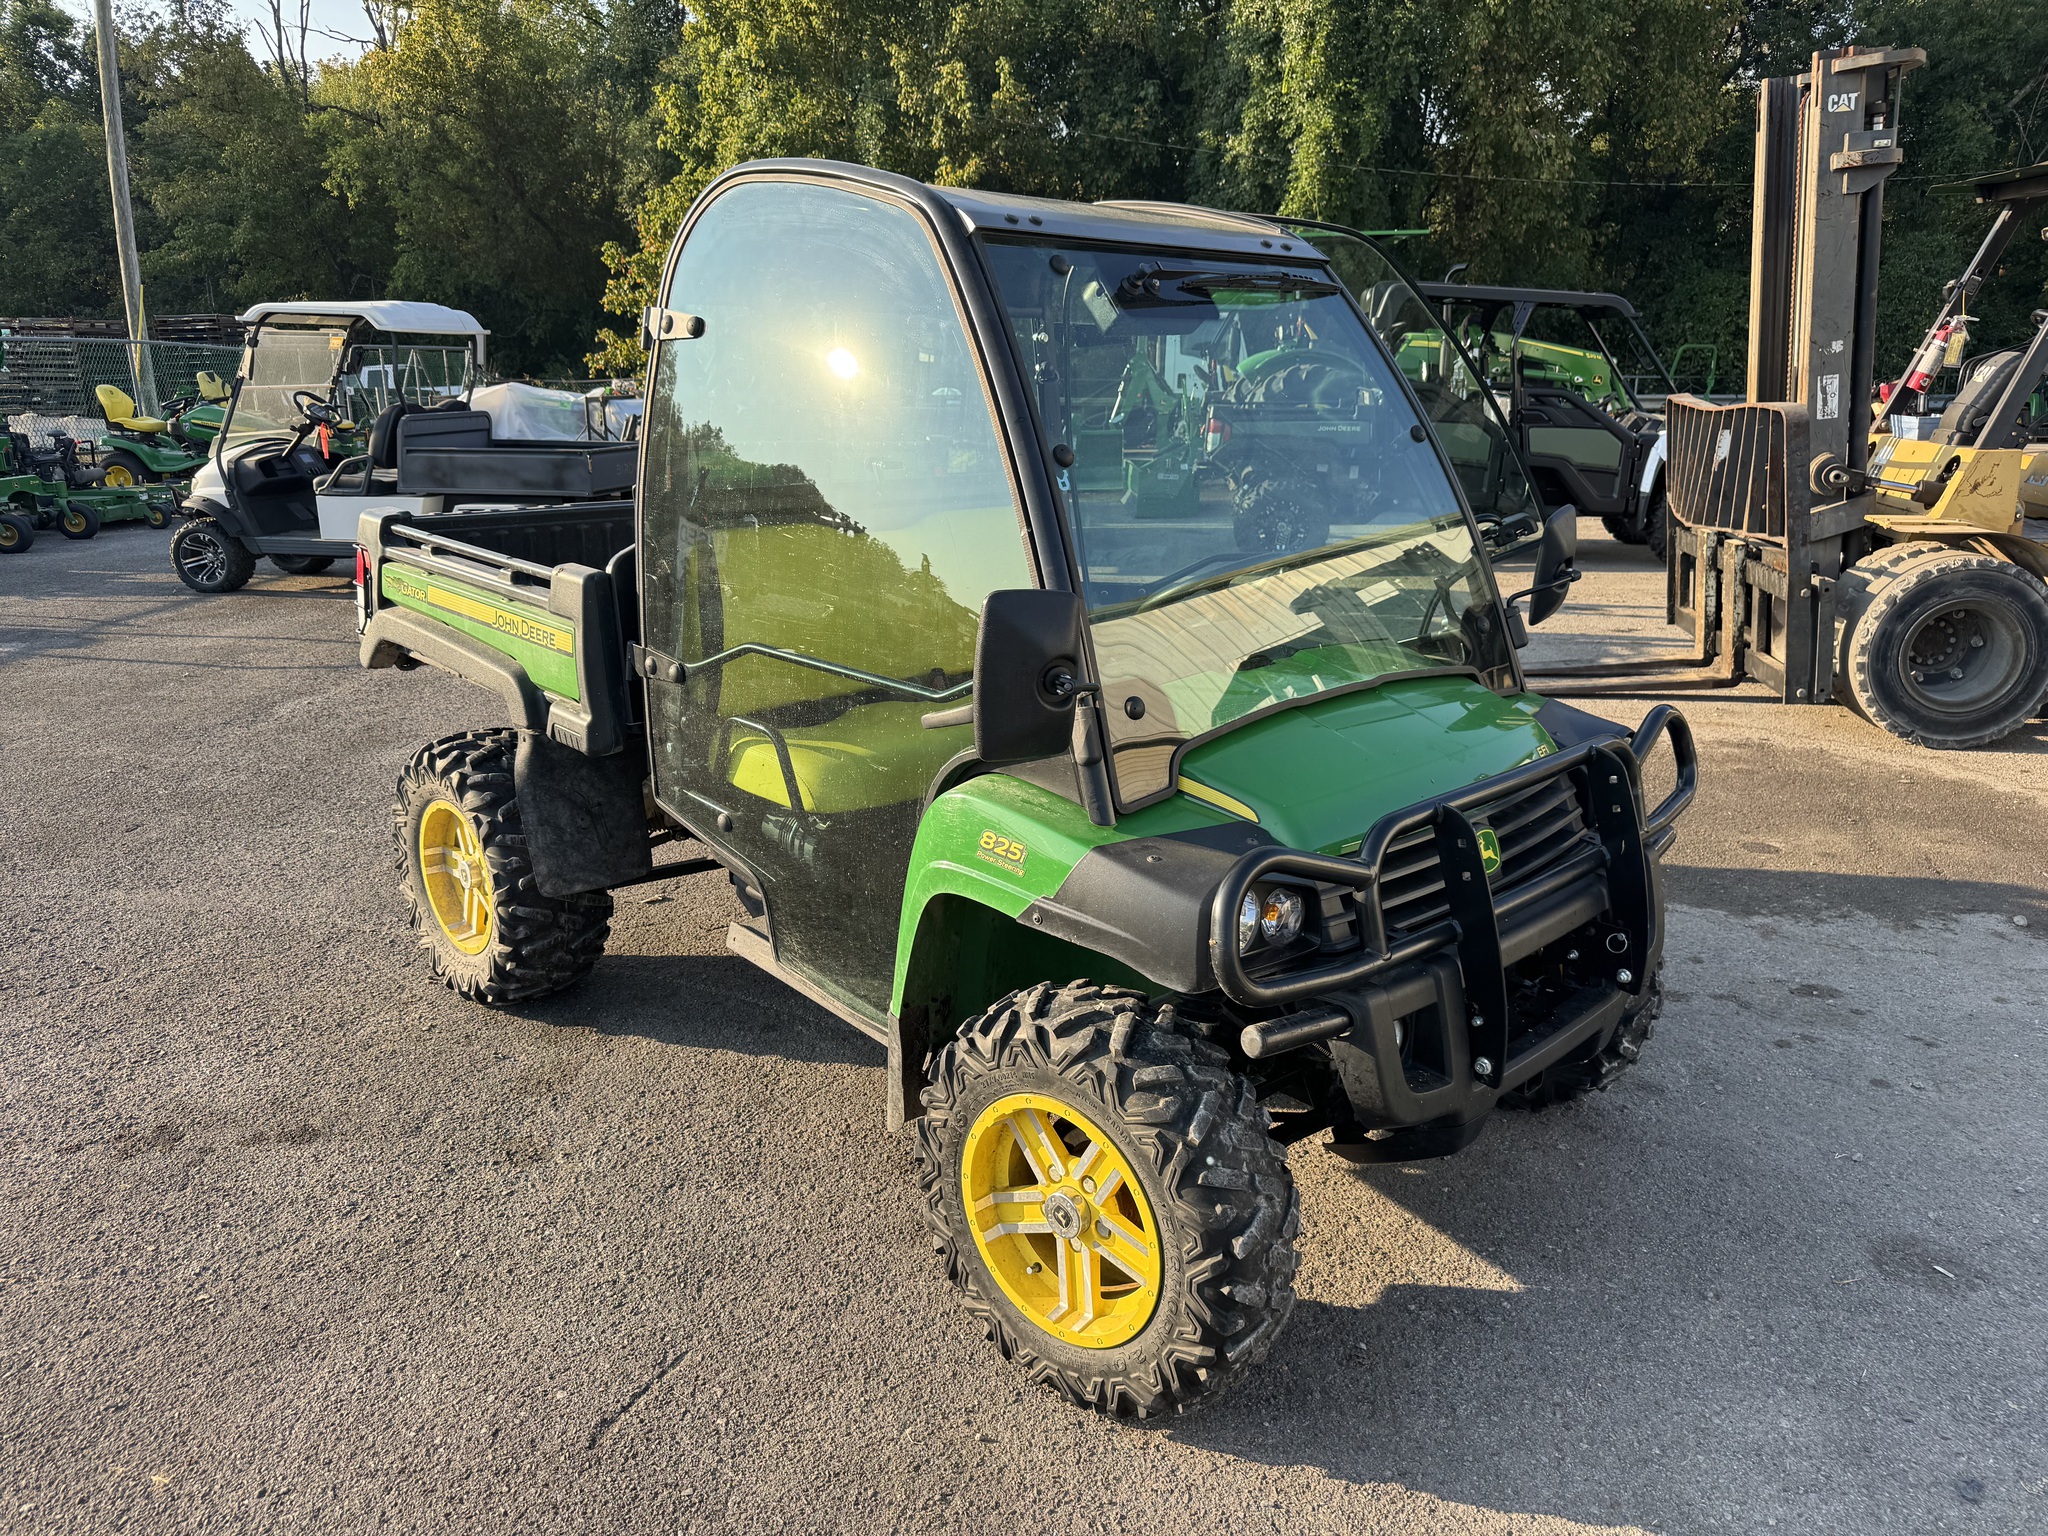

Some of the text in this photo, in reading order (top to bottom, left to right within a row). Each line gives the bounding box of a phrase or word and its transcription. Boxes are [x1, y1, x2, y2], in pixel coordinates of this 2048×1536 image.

[1828, 92, 1858, 112] CAT
[401, 583, 427, 602] GATOR
[491, 610, 556, 647] JOHN DEERE
[979, 830, 1027, 865] 825i
[976, 850, 1026, 877] Power Steering
[1105, 1114, 1132, 1146] RADIAL
